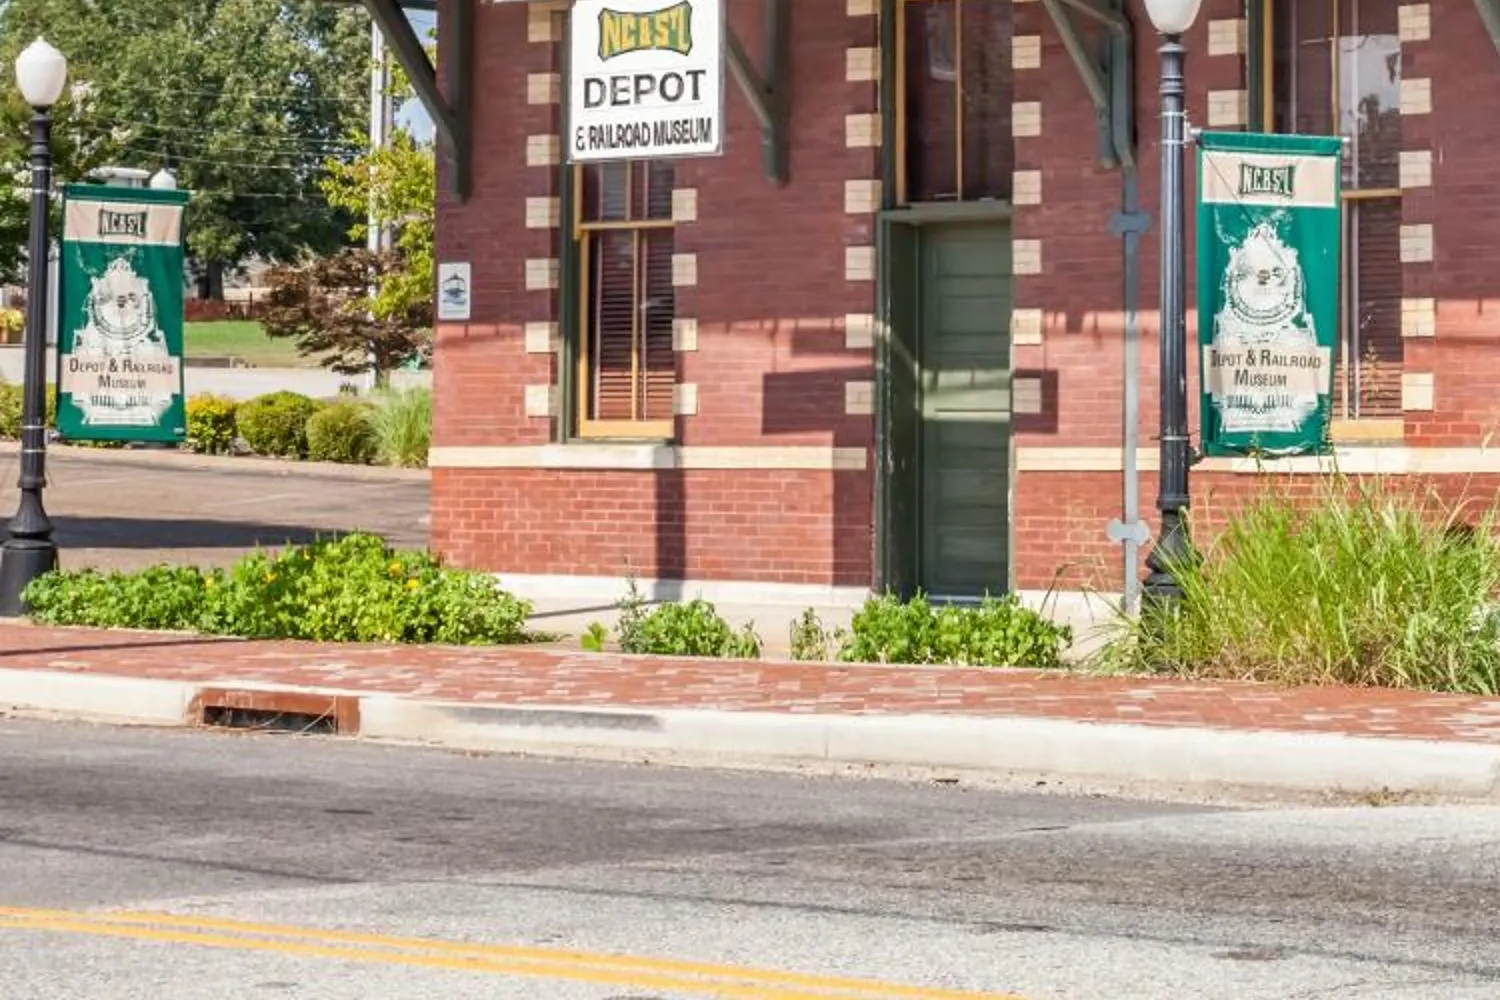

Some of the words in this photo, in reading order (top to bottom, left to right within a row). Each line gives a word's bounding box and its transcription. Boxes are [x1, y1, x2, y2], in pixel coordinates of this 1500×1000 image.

[583, 69, 706, 109] DEPOT
[588, 122, 651, 150] RAILROAD
[653, 117, 712, 147] MUSEUM
[69, 358, 105, 372] DEPOT
[109, 357, 118, 372] &
[1245, 349, 1257, 367] &
[1260, 349, 1322, 369] RAILROAD
[98, 374, 146, 388] MUSEUM
[1234, 368, 1287, 387] MUSEUM
